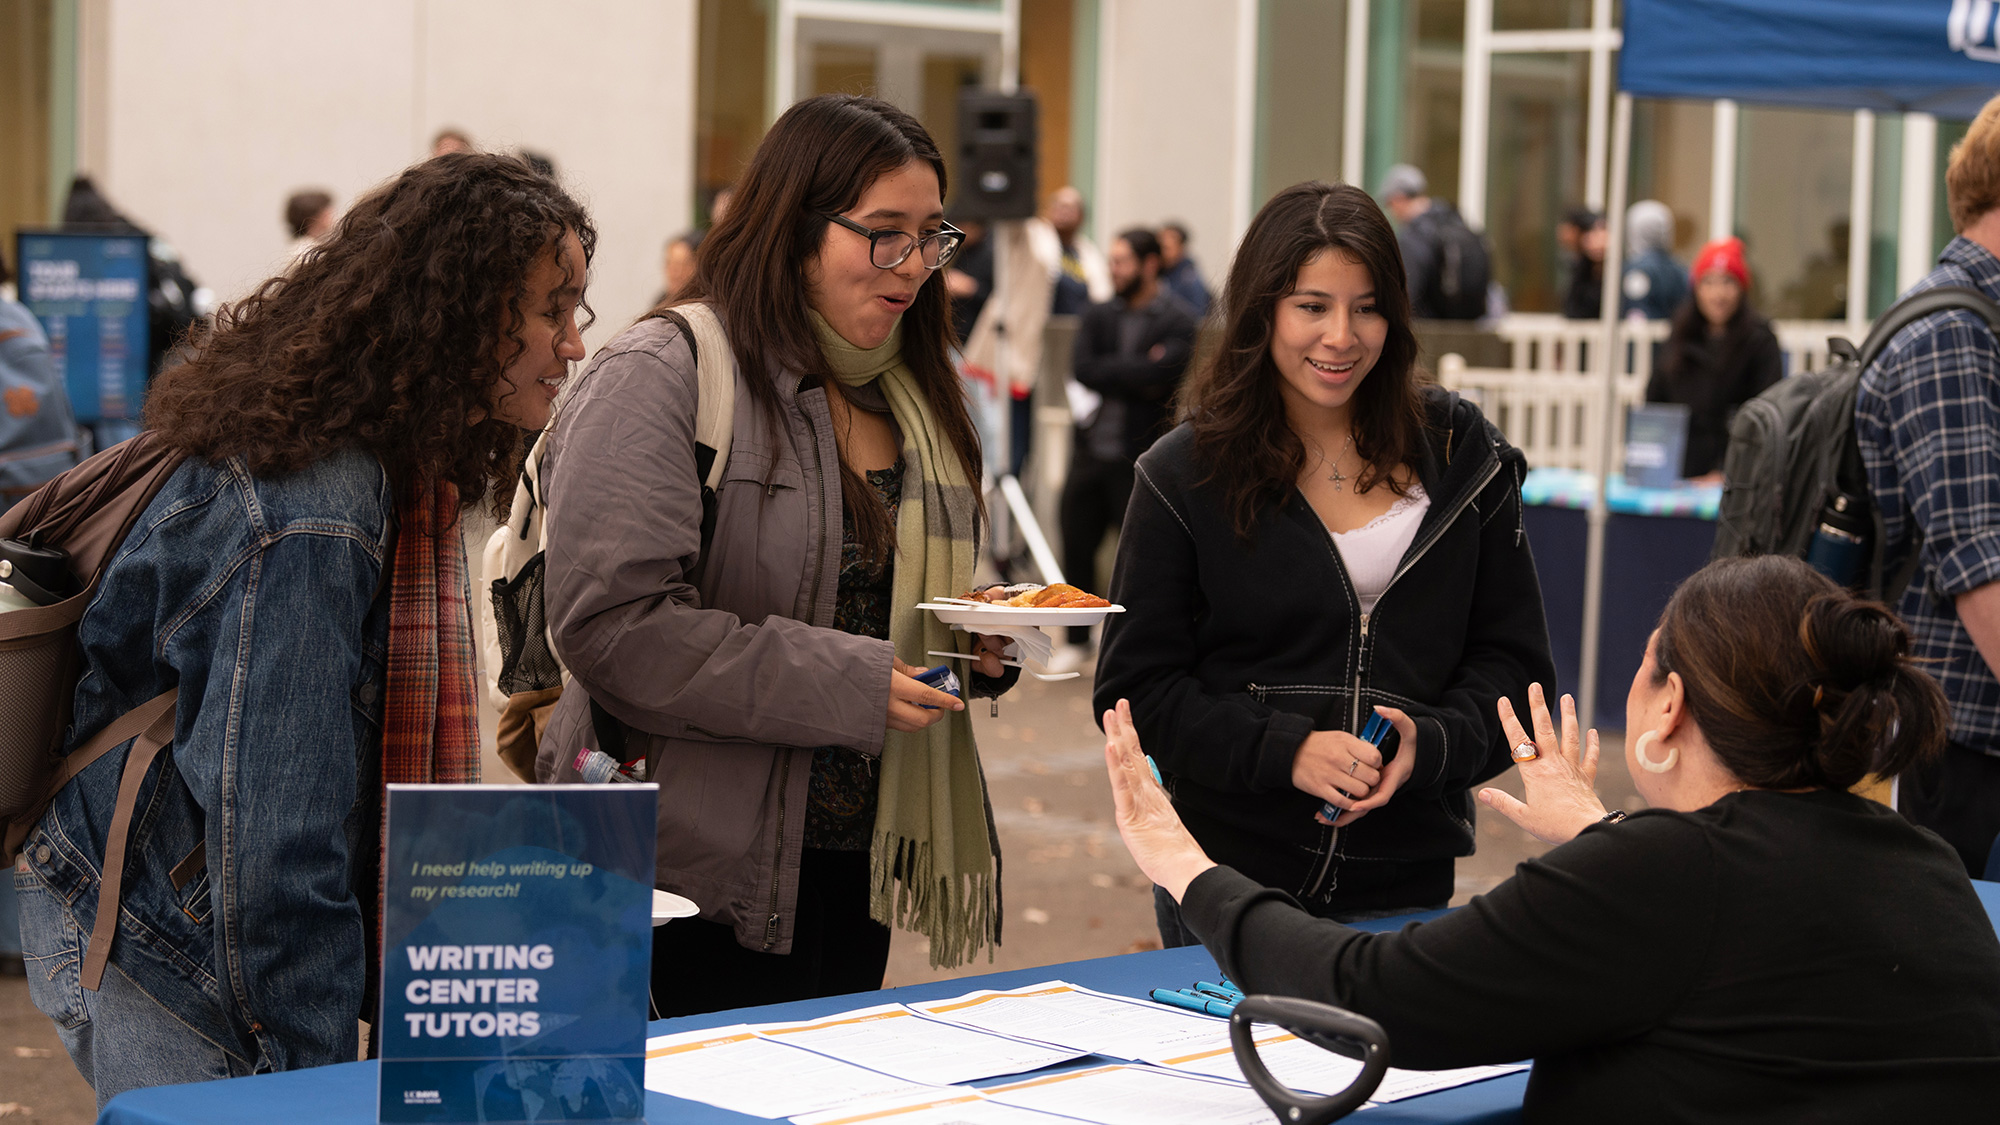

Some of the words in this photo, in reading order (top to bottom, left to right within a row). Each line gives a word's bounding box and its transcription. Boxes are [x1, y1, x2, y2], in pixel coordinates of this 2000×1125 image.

[411, 861, 419, 876] I
[421, 861, 466, 876] need
[468, 861, 506, 879] help
[510, 860, 566, 879] writing
[570, 863, 593, 878] up
[410, 886, 437, 901] my
[440, 882, 521, 898] research!
[406, 944, 555, 971] WRITING
[405, 978, 540, 1005] CENTER
[404, 1011, 541, 1038] TUTORS
